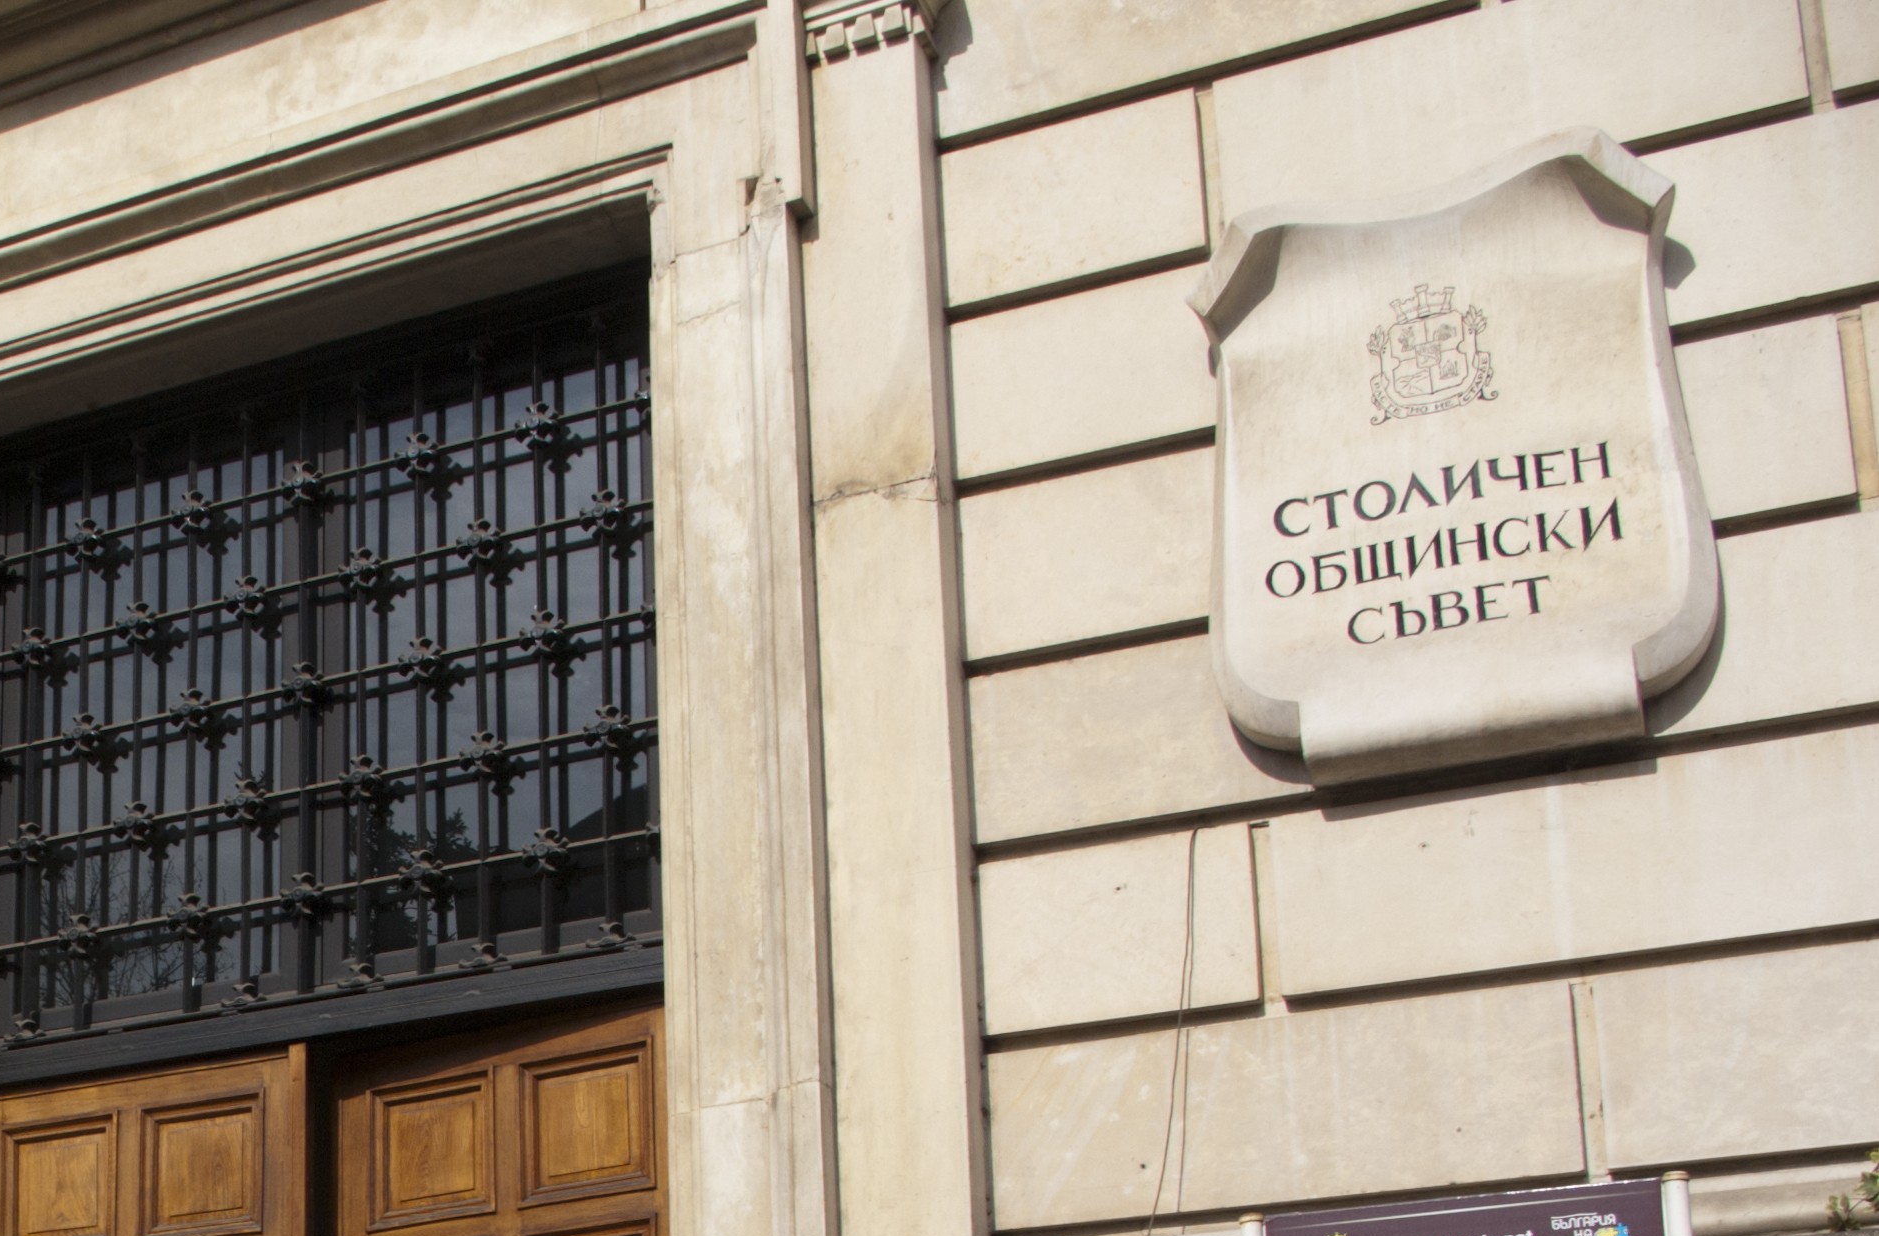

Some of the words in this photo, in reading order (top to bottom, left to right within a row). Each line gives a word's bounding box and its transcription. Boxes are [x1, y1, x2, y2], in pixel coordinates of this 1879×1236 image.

[1273, 441, 1612, 539] СТОЛИЧЕН
[1265, 498, 1624, 599] ОБЩИНСКИ
[1347, 575, 1551, 645] СЪВЕТ
[1551, 1213, 1616, 1230] БЪЛГАРИЯ
